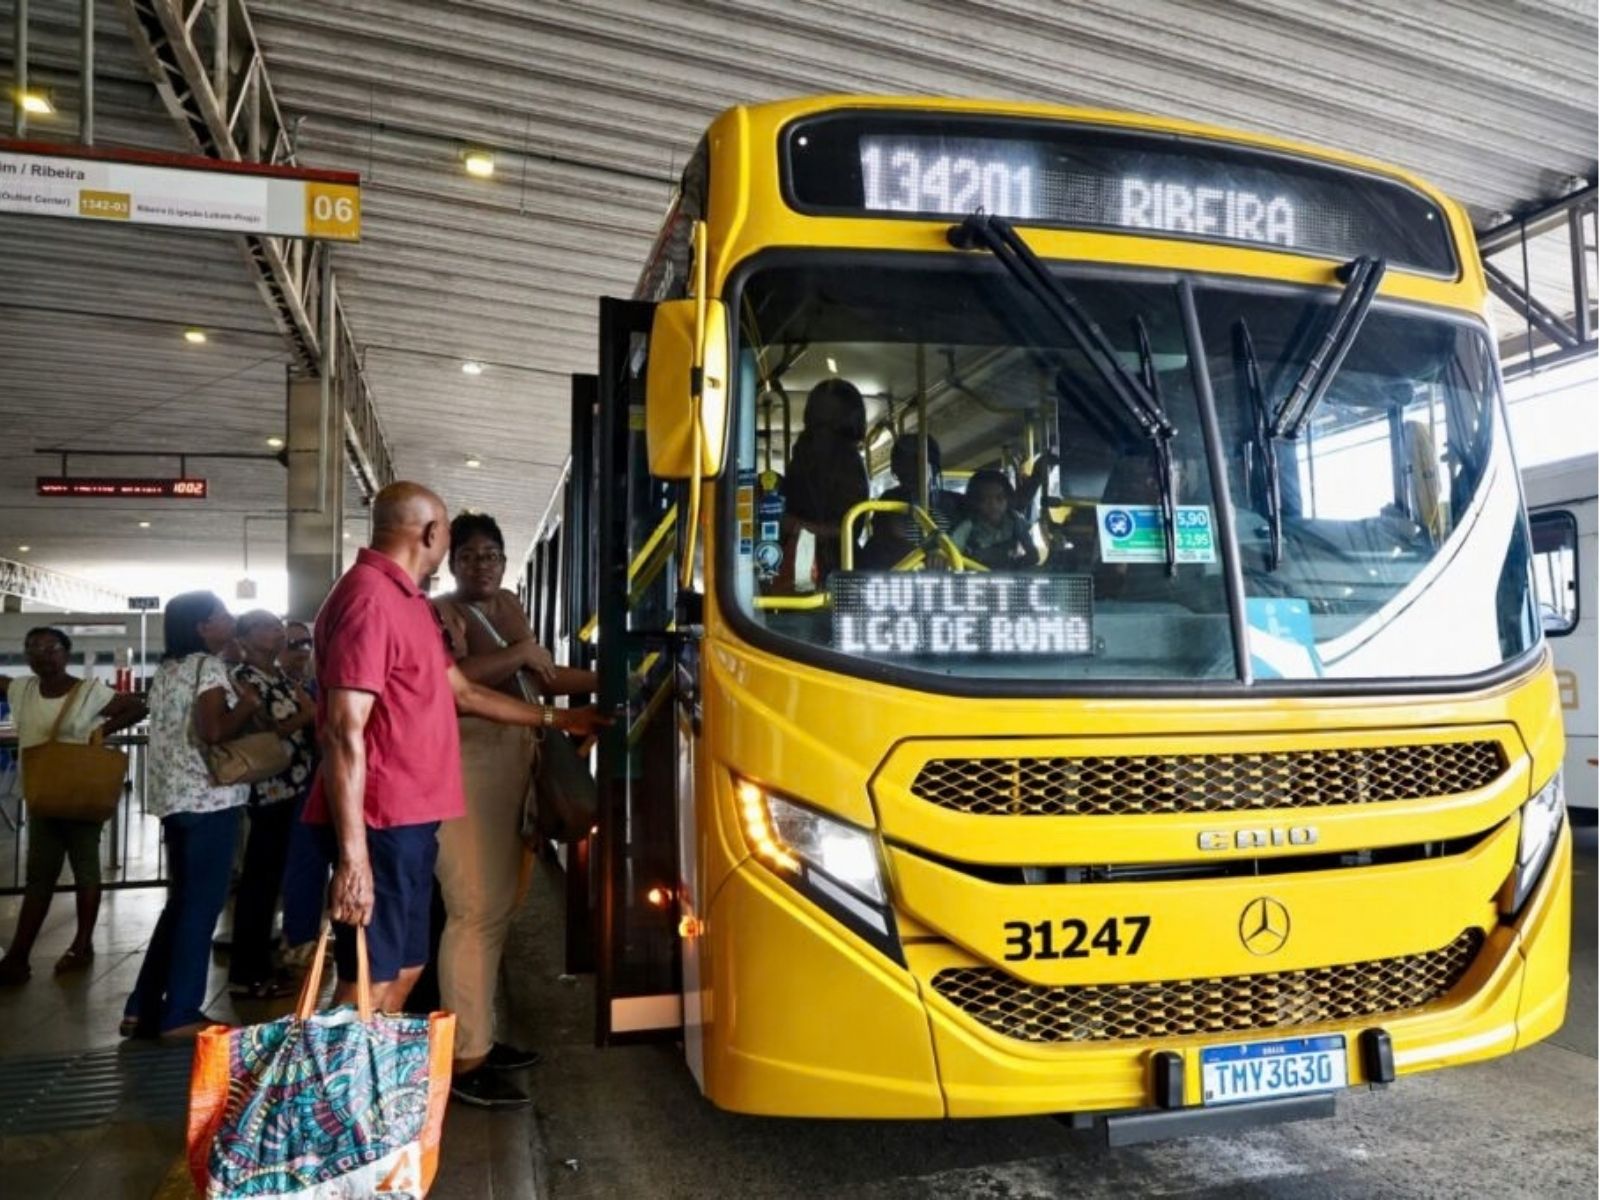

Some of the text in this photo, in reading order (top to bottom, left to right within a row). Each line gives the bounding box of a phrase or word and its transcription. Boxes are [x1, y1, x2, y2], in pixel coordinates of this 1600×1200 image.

[31, 164, 86, 181] Ribeira
[861, 145, 1030, 217] 134201
[314, 195, 353, 223] 06
[1121, 177, 1296, 247] RIBEIRA
[1176, 511, 1208, 528] 5,90
[864, 576, 1015, 612] OUTLET
[840, 614, 1092, 652] LGO DE ROMA
[1197, 828, 1317, 850] CAIO
[1004, 915, 1151, 961] 31247
[1215, 1054, 1332, 1095] TMY3G30
